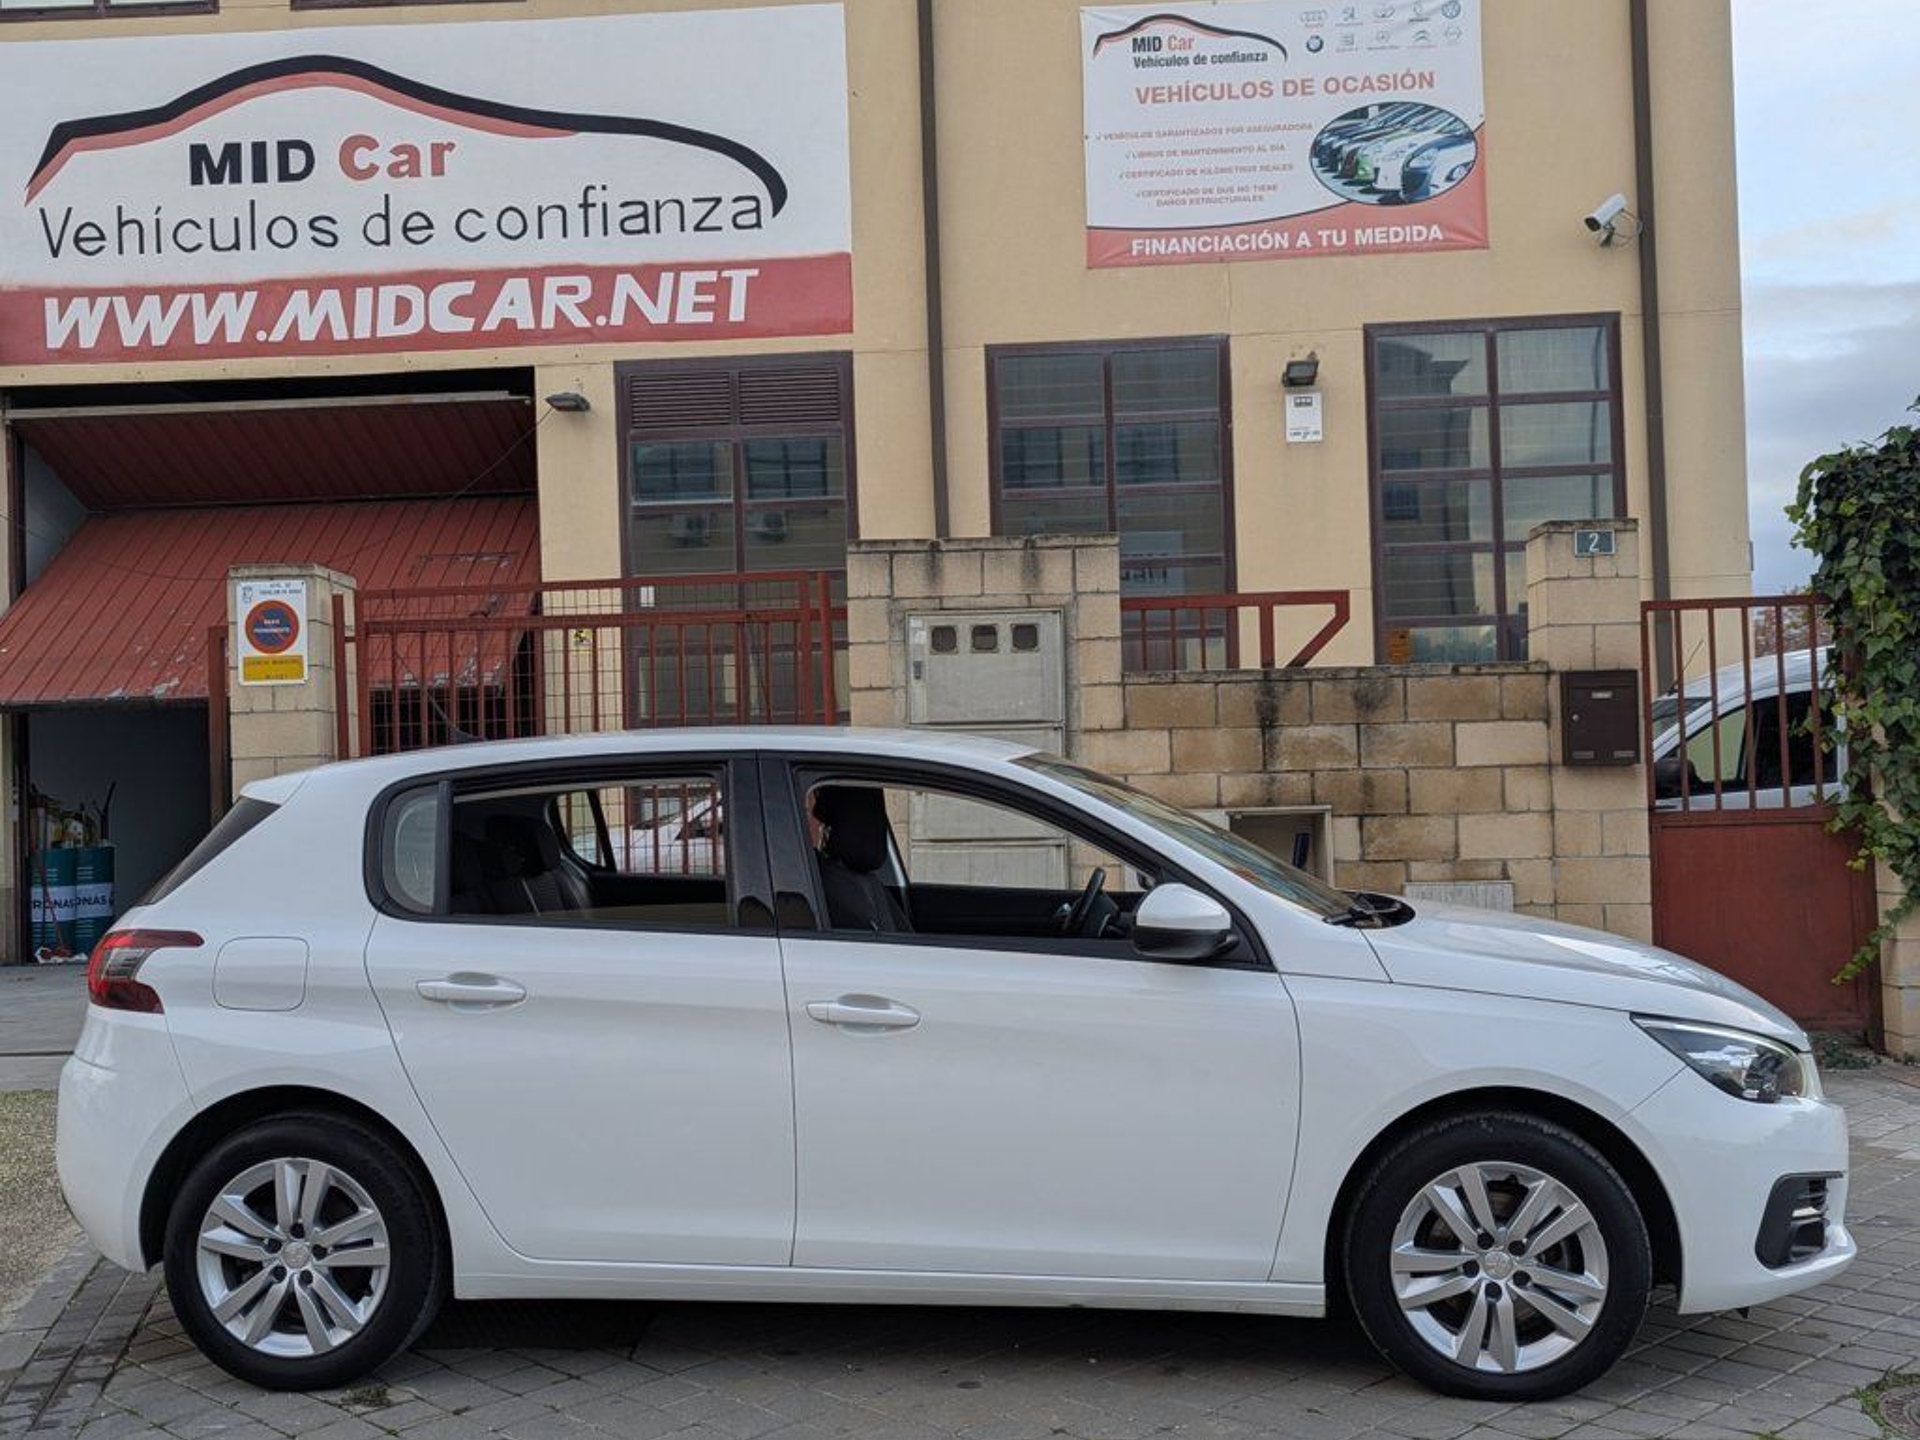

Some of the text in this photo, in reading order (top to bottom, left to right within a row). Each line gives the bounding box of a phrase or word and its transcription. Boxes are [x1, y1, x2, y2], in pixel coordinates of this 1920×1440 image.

[1132, 34, 1194, 53] MID Car
[1193, 53, 1208, 65] de
[1211, 50, 1268, 65] confianza
[1135, 69, 1435, 105] VEHÍCULOS DE OCASIÓN
[189, 134, 456, 186] MID Car
[39, 184, 763, 258] Vehículos de confianza
[1131, 224, 1444, 256] FINANCIACIÓN A TU MEDIDA
[44, 269, 760, 349] WWW.MIDCAR.NET
[1589, 532, 1600, 552] 2
